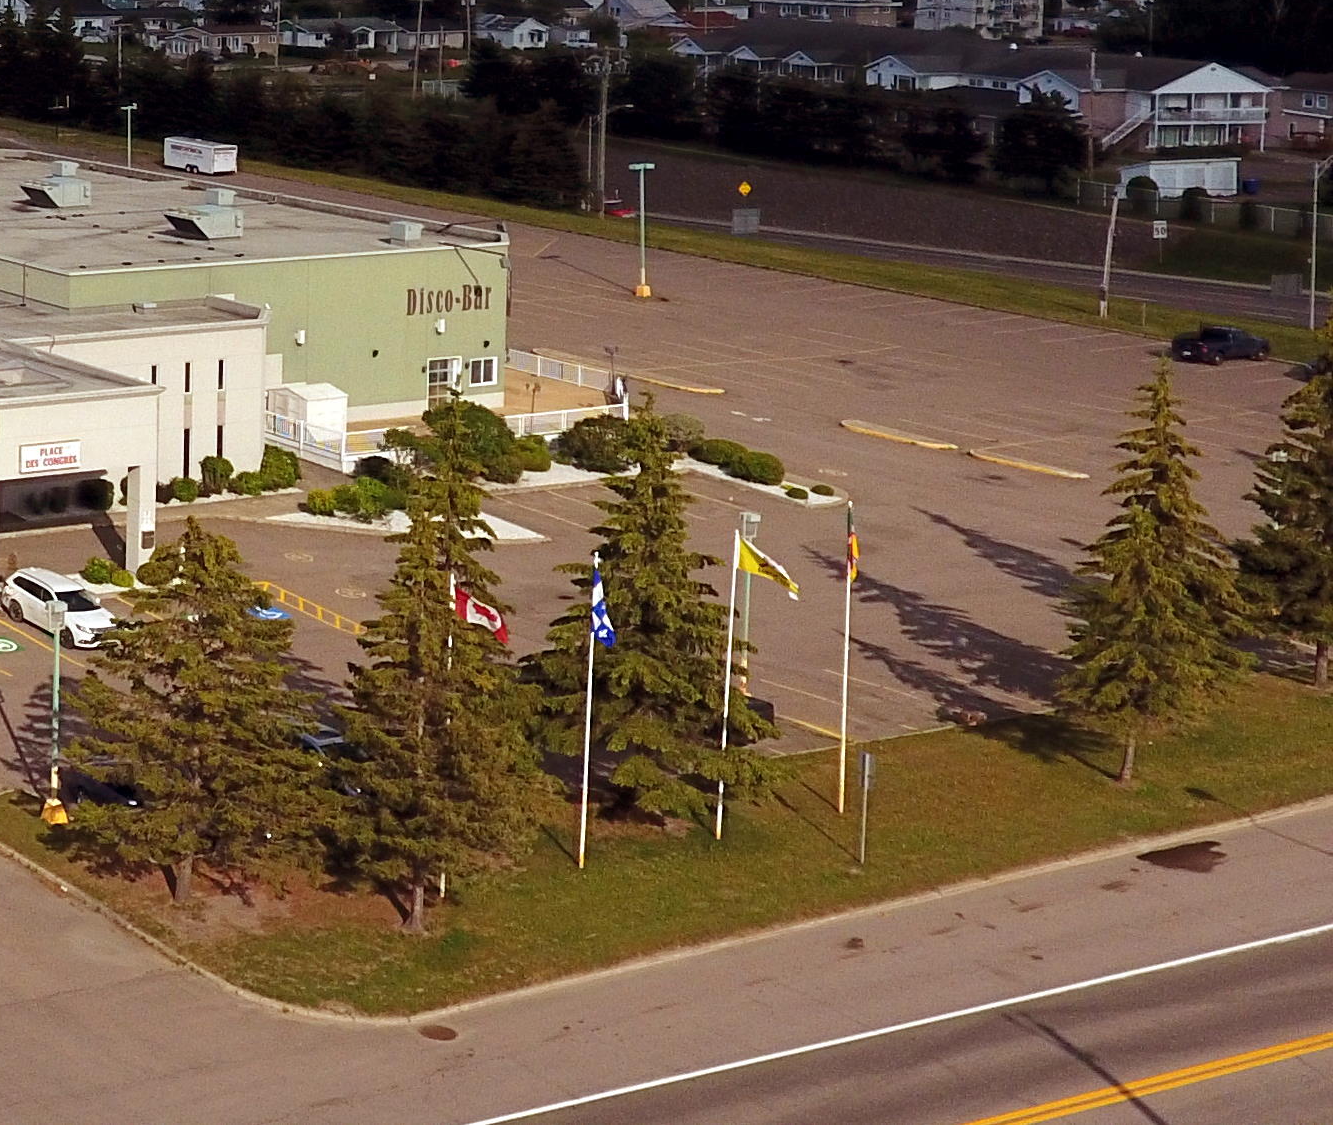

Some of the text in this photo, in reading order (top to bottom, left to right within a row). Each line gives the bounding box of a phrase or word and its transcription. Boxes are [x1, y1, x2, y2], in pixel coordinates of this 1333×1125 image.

[1154, 227, 1166, 235] 50
[406, 284, 492, 315] Disco-Bar
[40, 446, 63, 456] PLACE
[26, 459, 39, 468] DES
